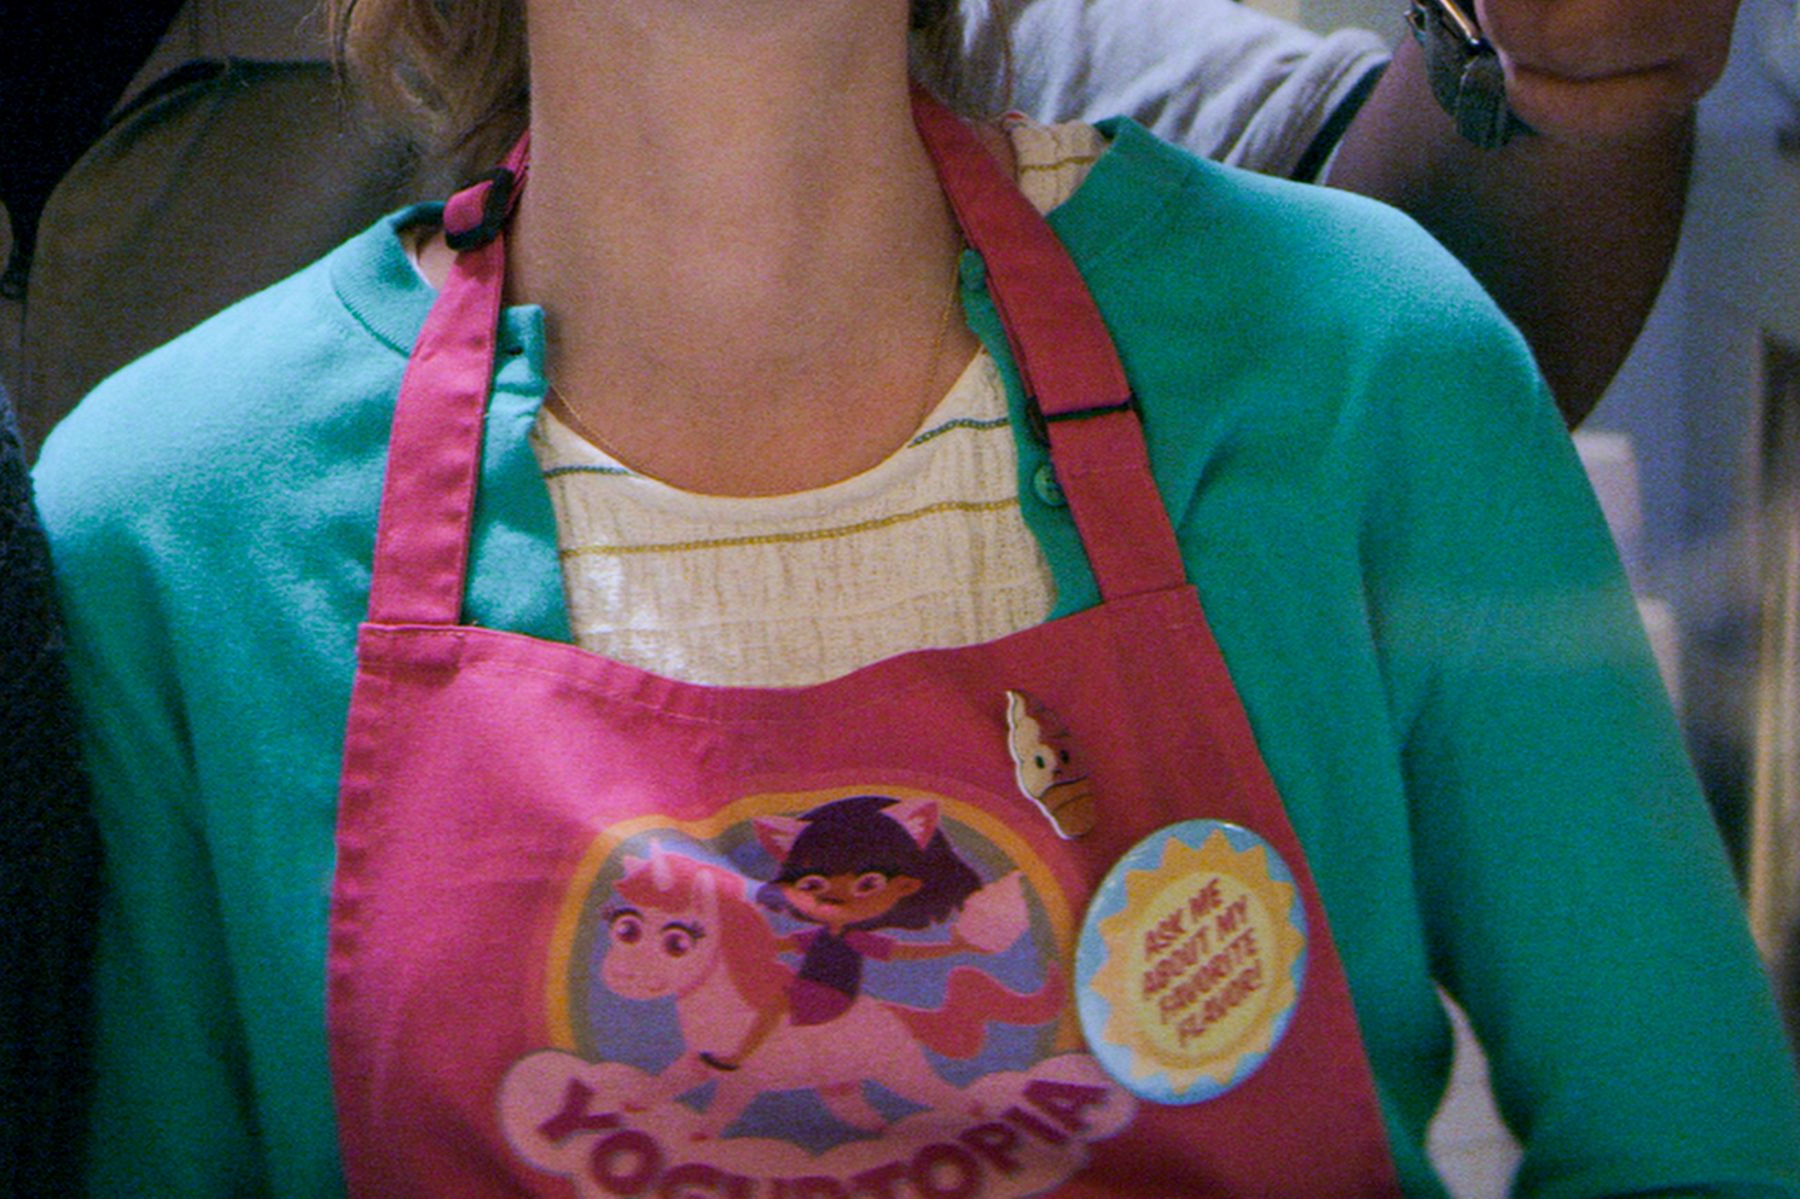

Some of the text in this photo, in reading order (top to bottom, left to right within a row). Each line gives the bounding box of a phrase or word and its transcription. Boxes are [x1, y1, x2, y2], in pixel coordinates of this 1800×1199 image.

[1142, 893, 1248, 1000] ABOUT MY
[1144, 877, 1223, 961] ASK ME
[1159, 927, 1257, 1025] FAVORITE
